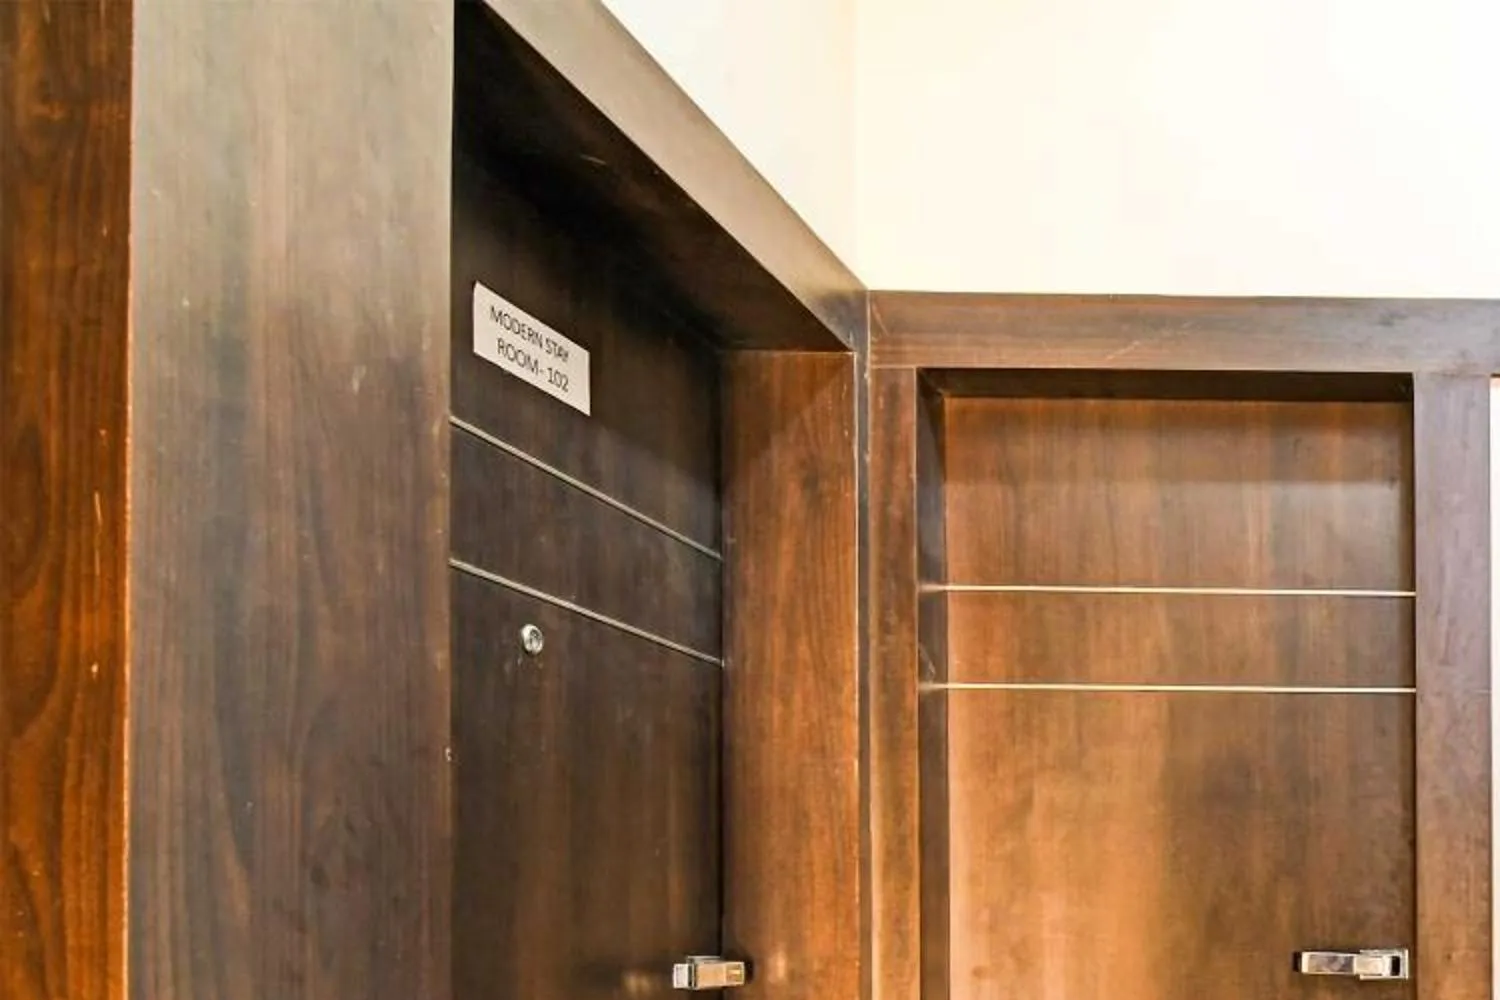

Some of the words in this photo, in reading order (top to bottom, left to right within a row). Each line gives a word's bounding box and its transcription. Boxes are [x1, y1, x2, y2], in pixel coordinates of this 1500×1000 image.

[489, 305, 543, 350] MODERN
[545, 336, 569, 363] STAY
[497, 337, 545, 376] ROOM-
[547, 367, 569, 393] 102
